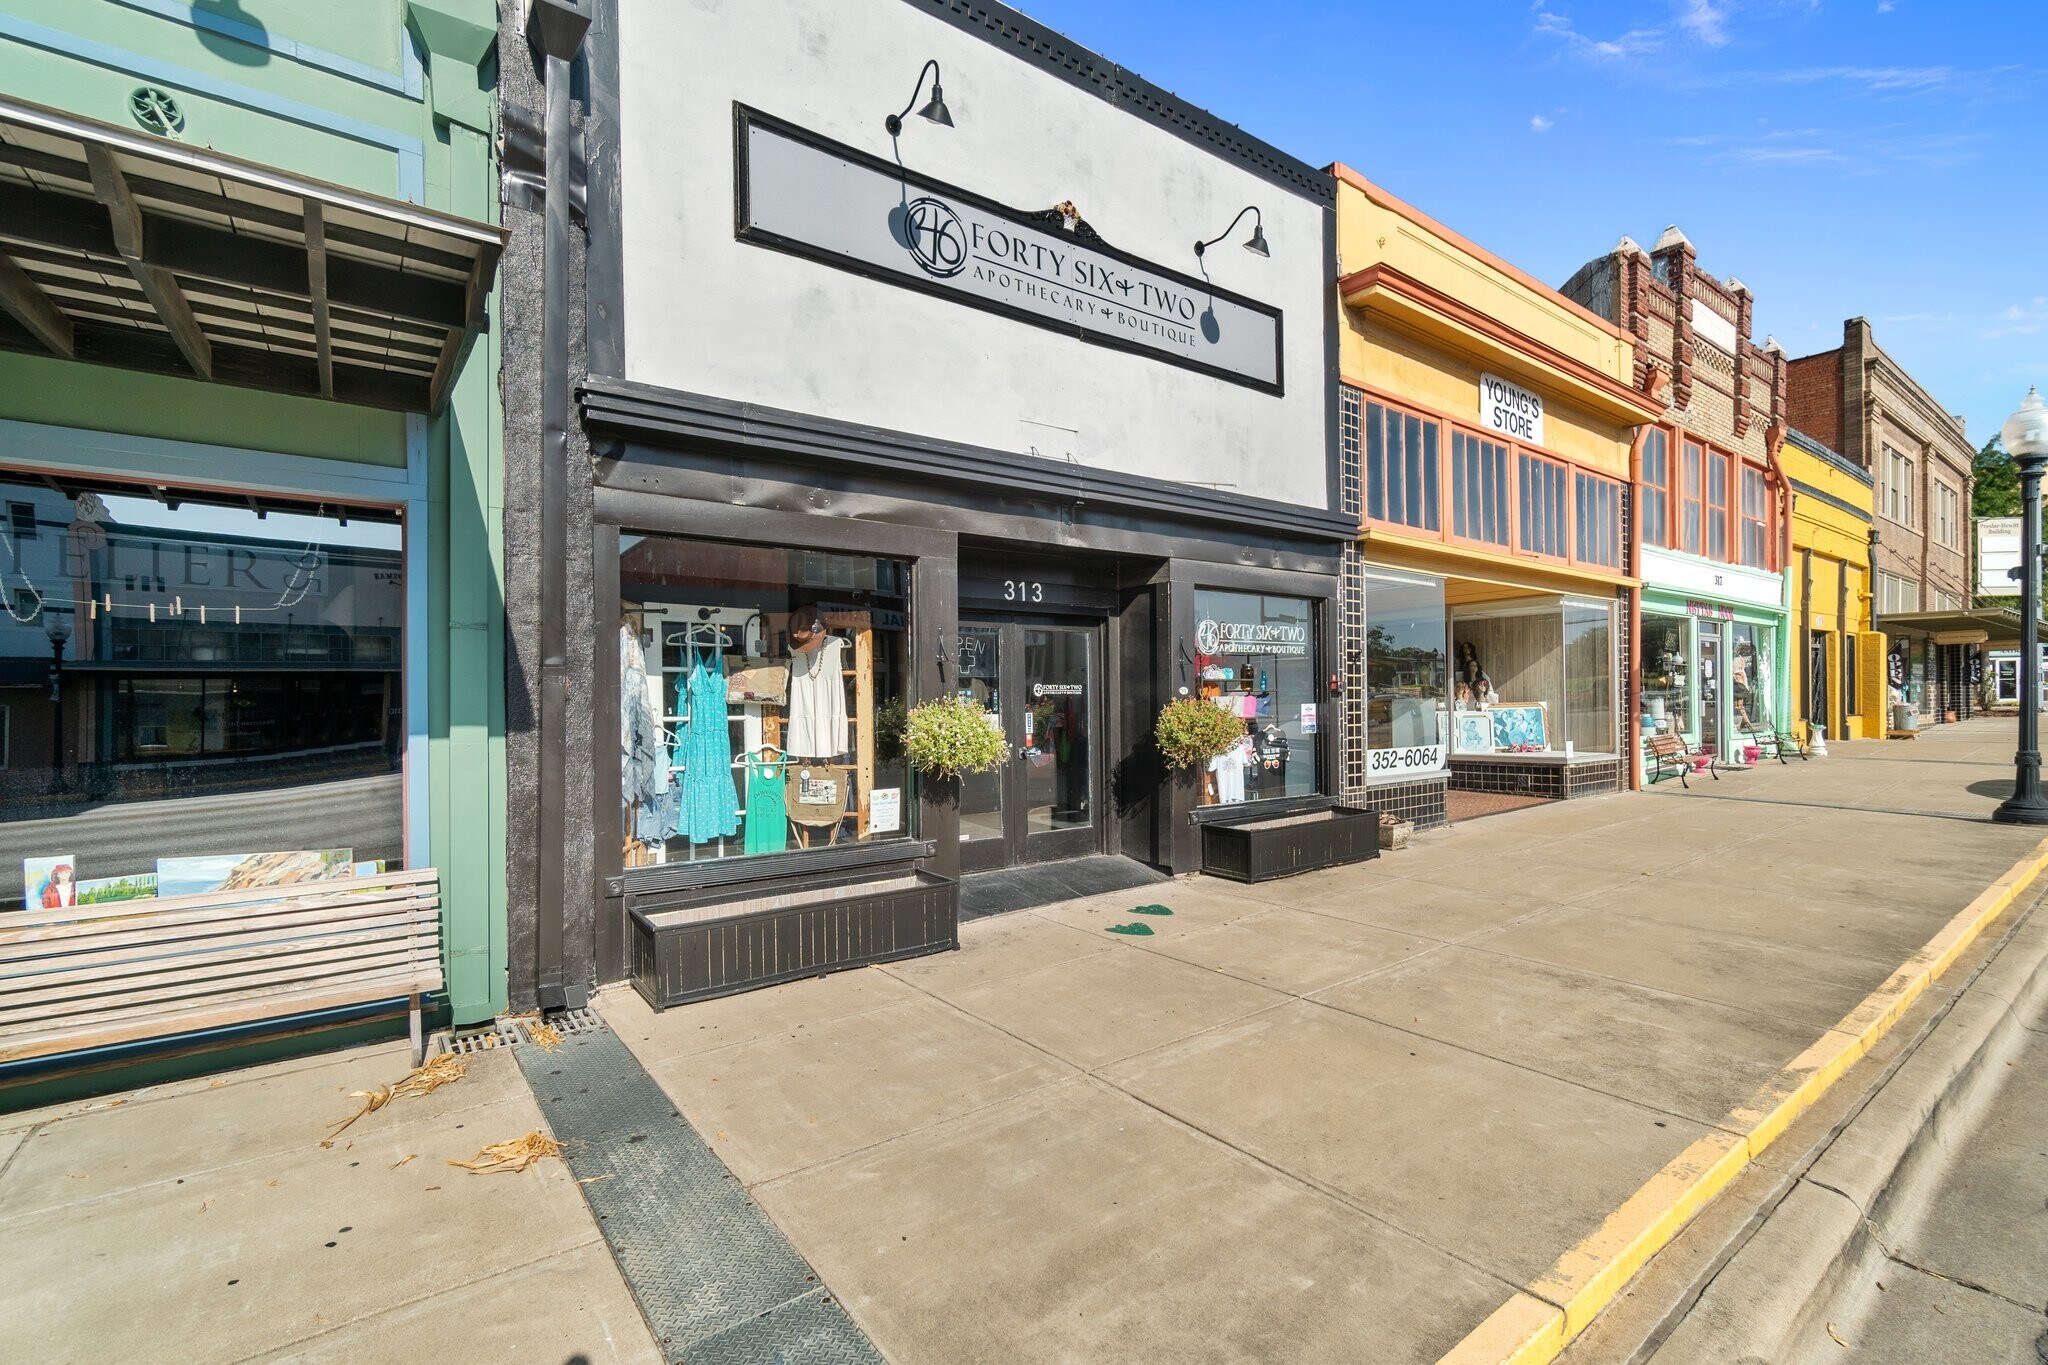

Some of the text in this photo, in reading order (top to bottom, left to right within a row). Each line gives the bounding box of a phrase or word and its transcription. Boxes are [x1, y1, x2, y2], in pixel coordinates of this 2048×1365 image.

[972, 222, 1066, 277] FORTY
[1074, 260, 1114, 295] SIX
[1138, 282, 1195, 320] TWO
[973, 265, 1096, 315] APOTHECARY
[1117, 311, 1196, 347] BOUTIQUE
[1485, 377, 1540, 419] YOUNG'S
[1493, 406, 1533, 440] STORE
[1004, 580, 1043, 603] 313
[1220, 623, 1255, 640] FORTY
[1256, 624, 1272, 640] SIX
[1280, 625, 1305, 642] TWO
[957, 636, 986, 655] PEN
[1219, 643, 1265, 654] APOTHECARY
[1273, 645, 1305, 655] BOUTIQUE
[1372, 747, 1438, 770] 352-6064
